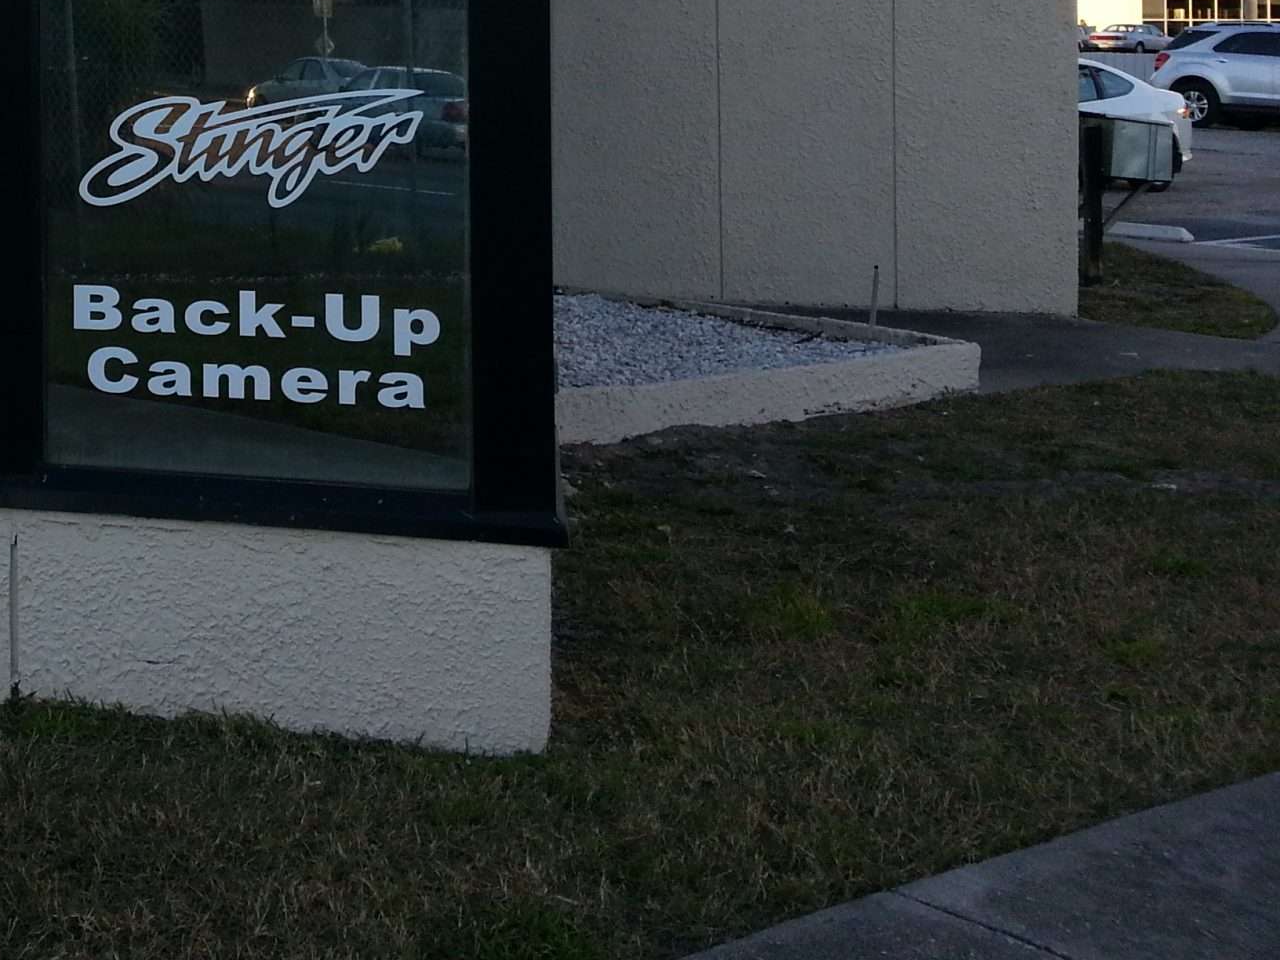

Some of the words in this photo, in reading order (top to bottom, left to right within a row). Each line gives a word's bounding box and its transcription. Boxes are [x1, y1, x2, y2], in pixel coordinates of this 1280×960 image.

[79, 88, 425, 208] Stinger
[73, 284, 441, 356] Back-Up
[87, 346, 426, 409] Camera
